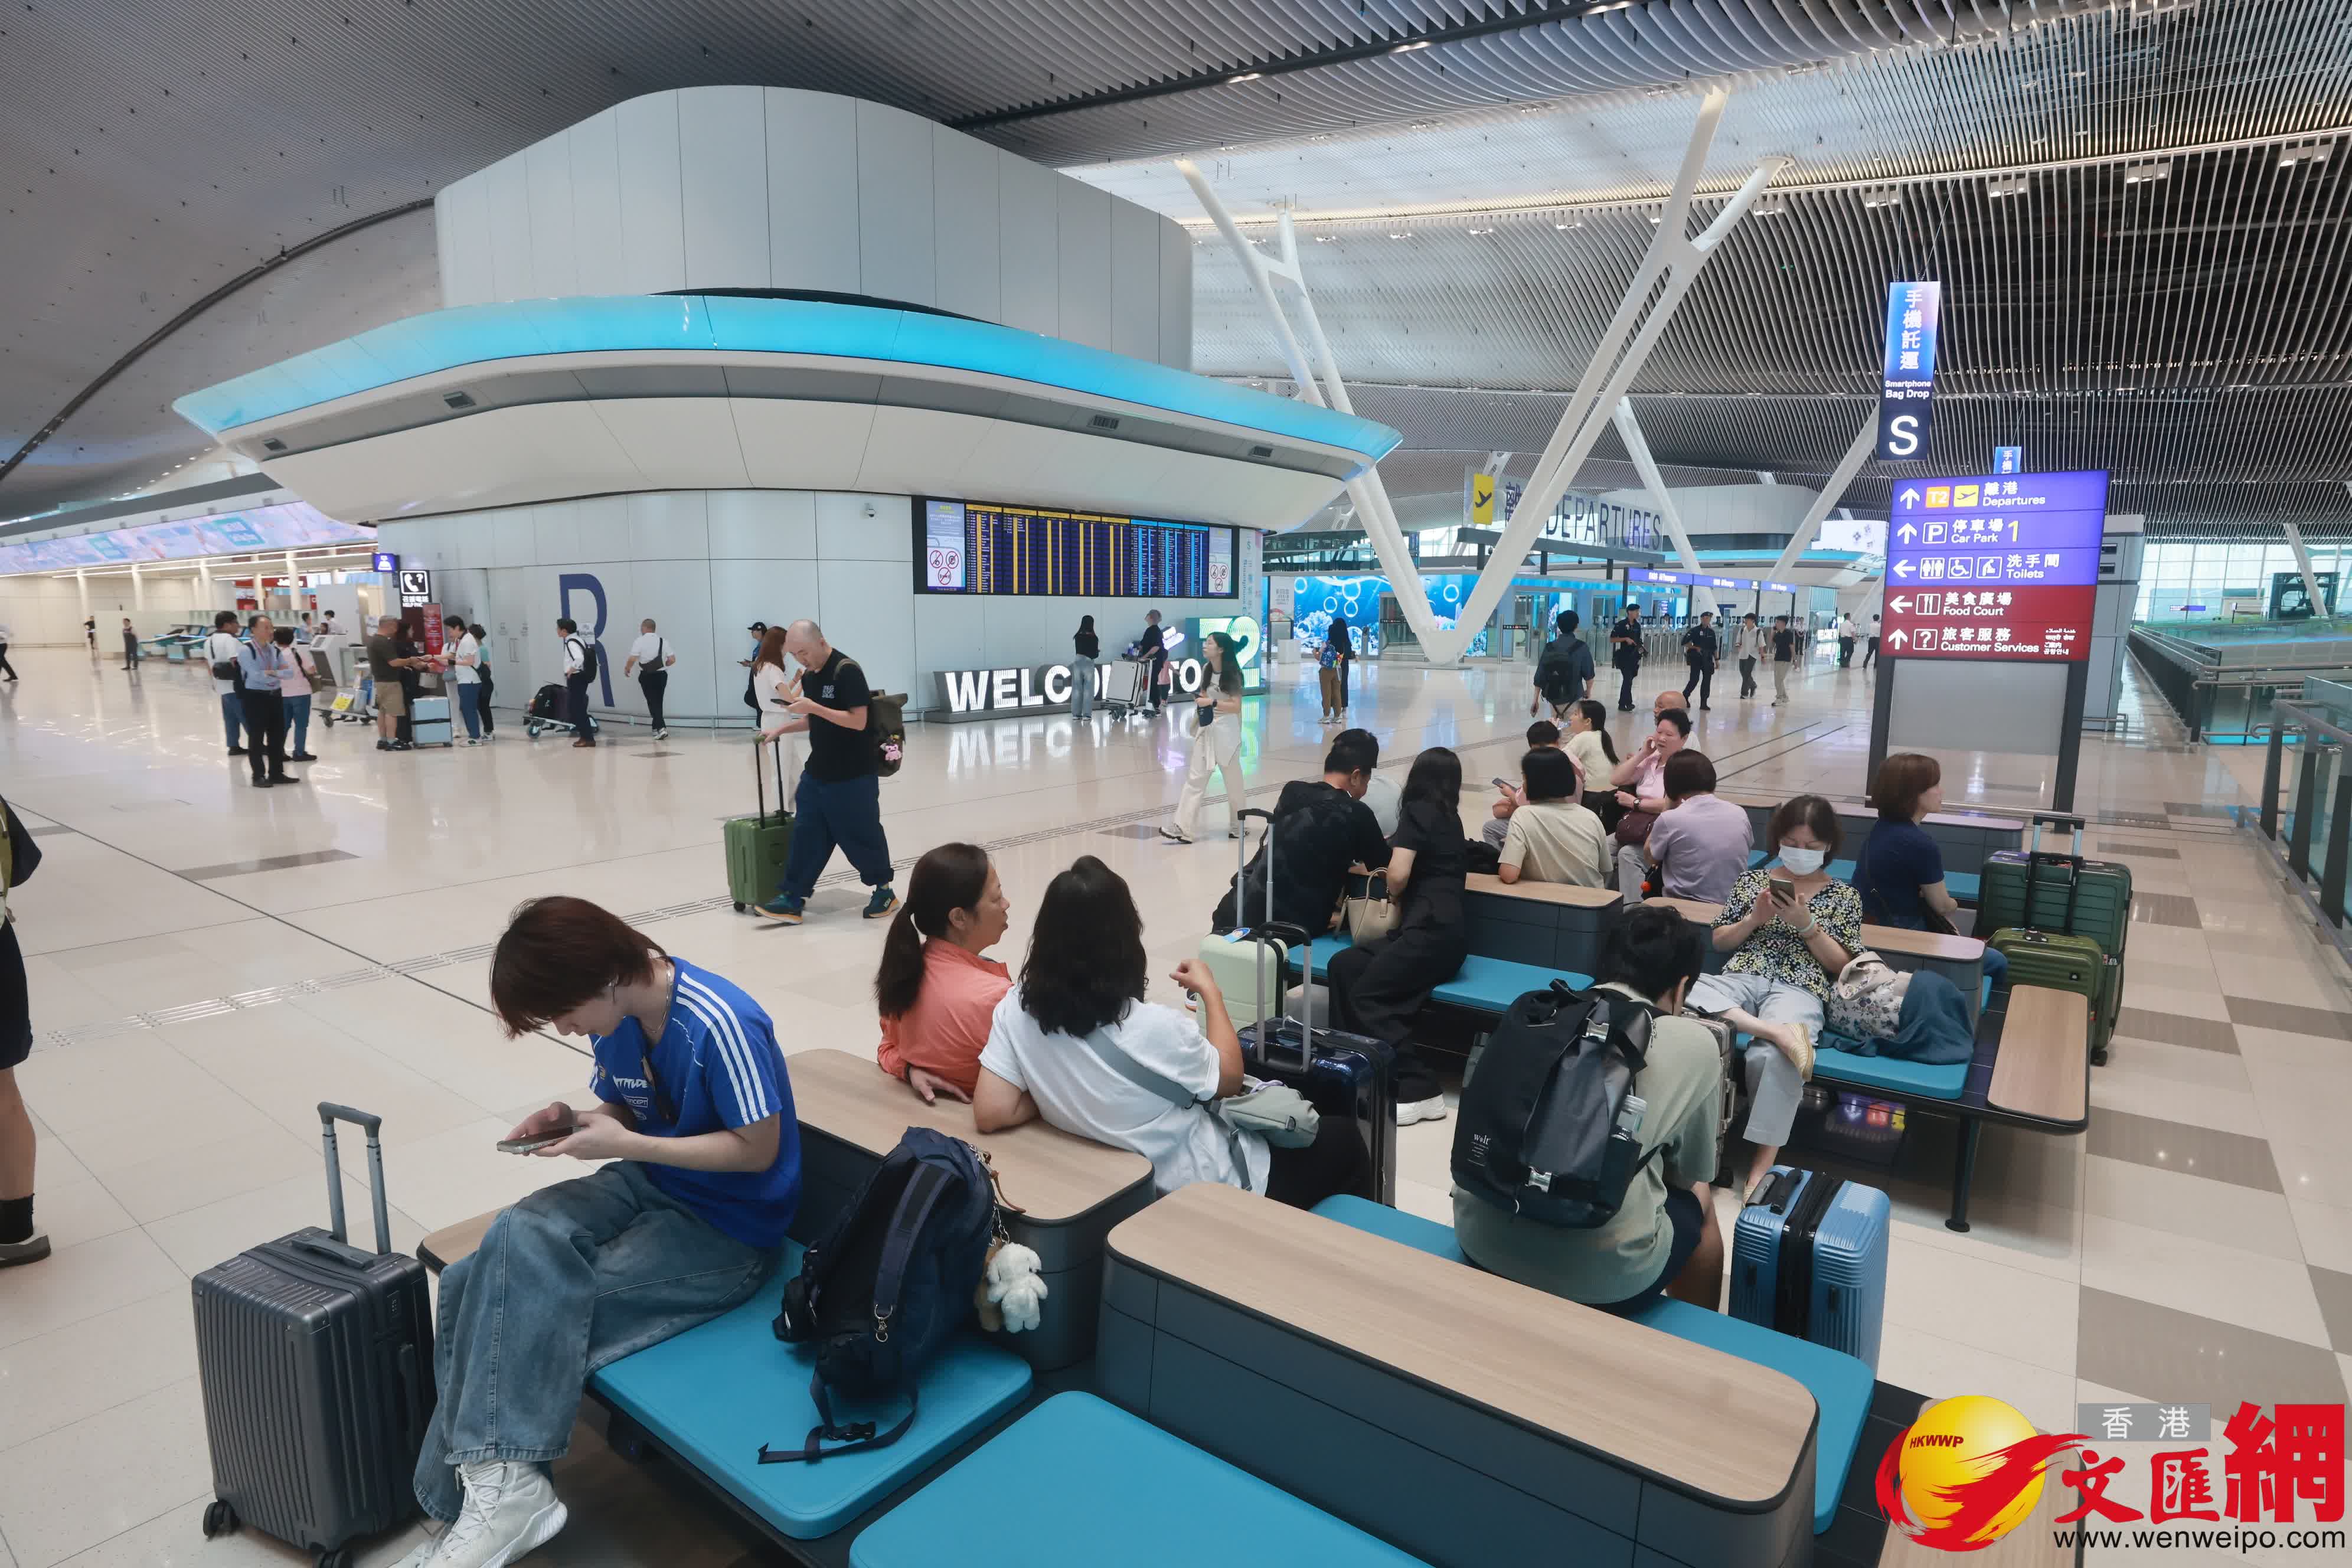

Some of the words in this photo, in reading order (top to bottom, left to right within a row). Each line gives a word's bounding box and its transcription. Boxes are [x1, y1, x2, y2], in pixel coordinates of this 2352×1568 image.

[1900, 289, 1922, 370] 手機託運
[1885, 380, 1931, 388] Smartphone
[1886, 390, 1904, 400] Bag
[1906, 389, 1929, 399] Drop
[1889, 416, 1918, 455] S
[2002, 450, 2013, 473] 手機
[1984, 481, 2018, 496] 離港
[1930, 491, 1948, 504] T2
[1982, 496, 2046, 508] Departures
[1952, 518, 2004, 533] 停車場
[2008, 521, 2019, 542] 1
[1928, 525, 1943, 541] P
[1951, 534, 1971, 543] Car
[1974, 534, 1998, 543] Park
[2007, 554, 2060, 568] 洗手間
[2006, 569, 2044, 579] Toilets
[1944, 592, 2013, 606] 美食廣場
[1943, 607, 1970, 616] Food
[1973, 607, 2004, 616] Court
[1942, 628, 2011, 641] 旅客服務
[1941, 641, 1991, 652] Customer
[1994, 642, 2039, 652] Services
